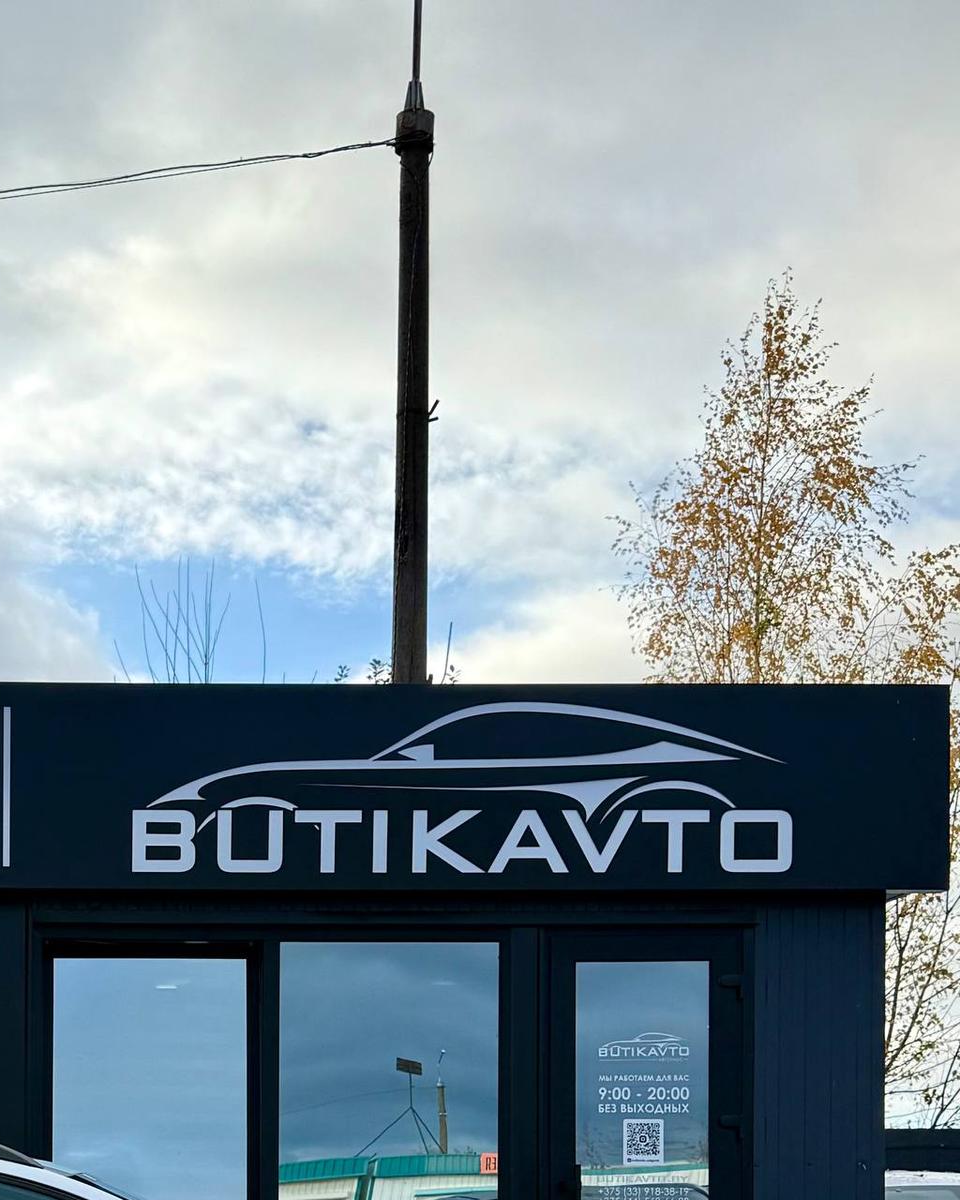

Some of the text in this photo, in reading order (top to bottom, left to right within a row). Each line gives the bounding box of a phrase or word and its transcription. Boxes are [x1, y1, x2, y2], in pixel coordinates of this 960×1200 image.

[131, 808, 793, 874] BUTIKAVTO
[598, 1047, 690, 1057] BUTIKAVTO
[598, 1087, 631, 1101] 9:00
[647, 1087, 690, 1101] 20:00
[598, 1104, 690, 1114] БЕЗ ВЫХОДНЫХ
[598, 1187, 689, 1197] +375 (33) 918-38-19
